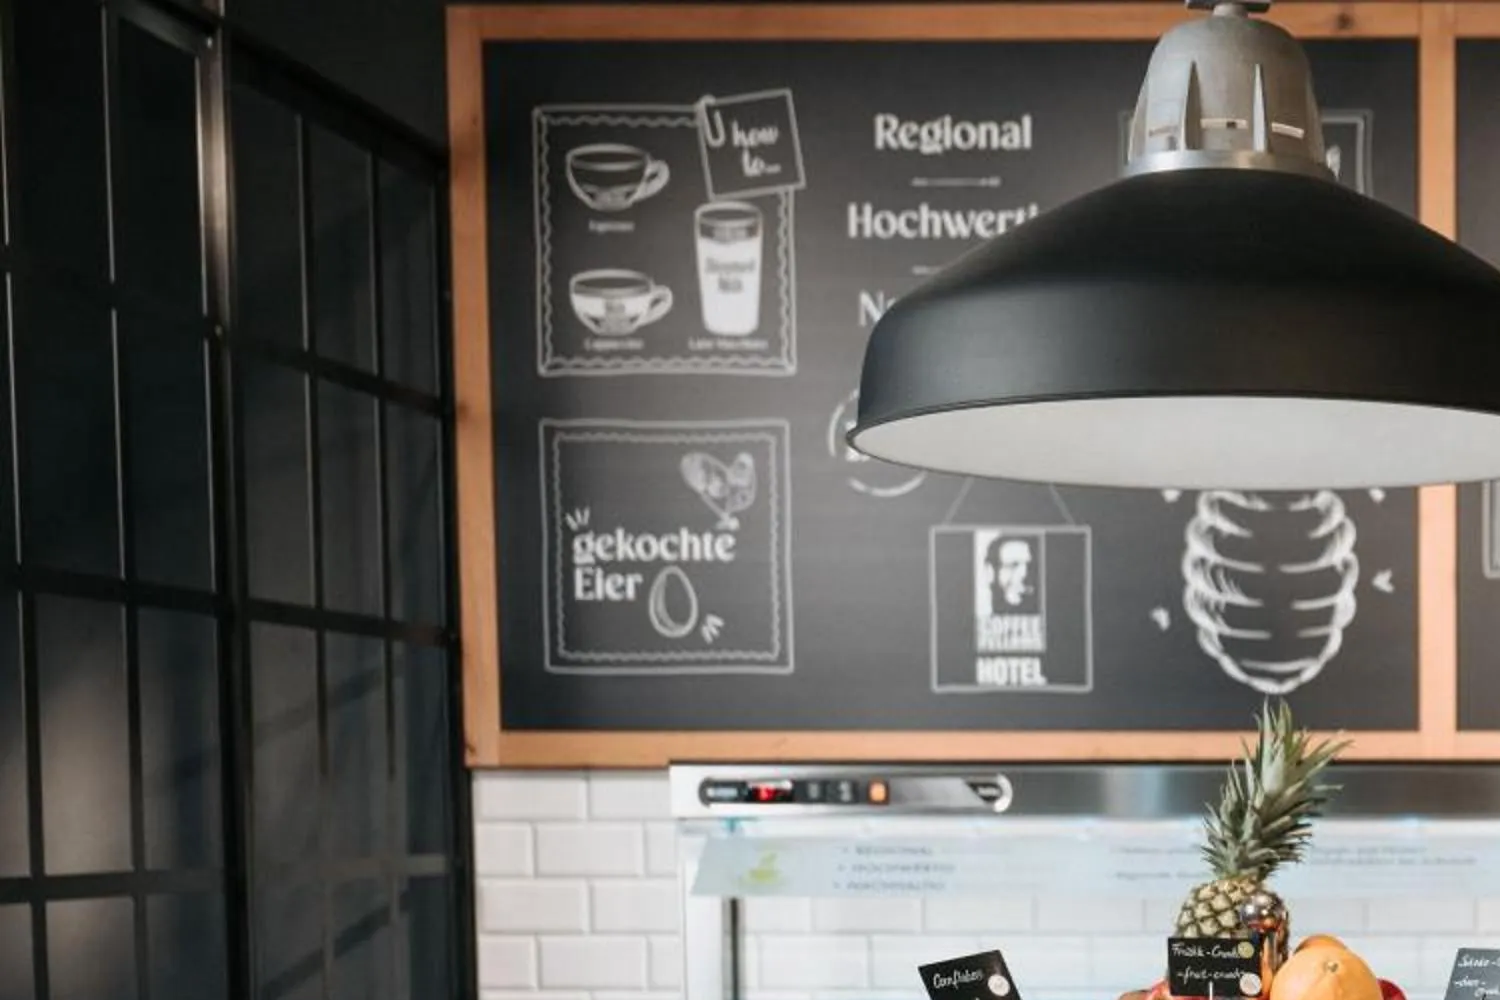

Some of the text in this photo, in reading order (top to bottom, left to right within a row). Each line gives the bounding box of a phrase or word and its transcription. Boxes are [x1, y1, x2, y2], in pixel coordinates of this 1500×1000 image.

[733, 119, 778, 147] how
[874, 113, 1033, 154] Regional
[573, 526, 737, 565] gekochte
[573, 566, 643, 601] Eier
